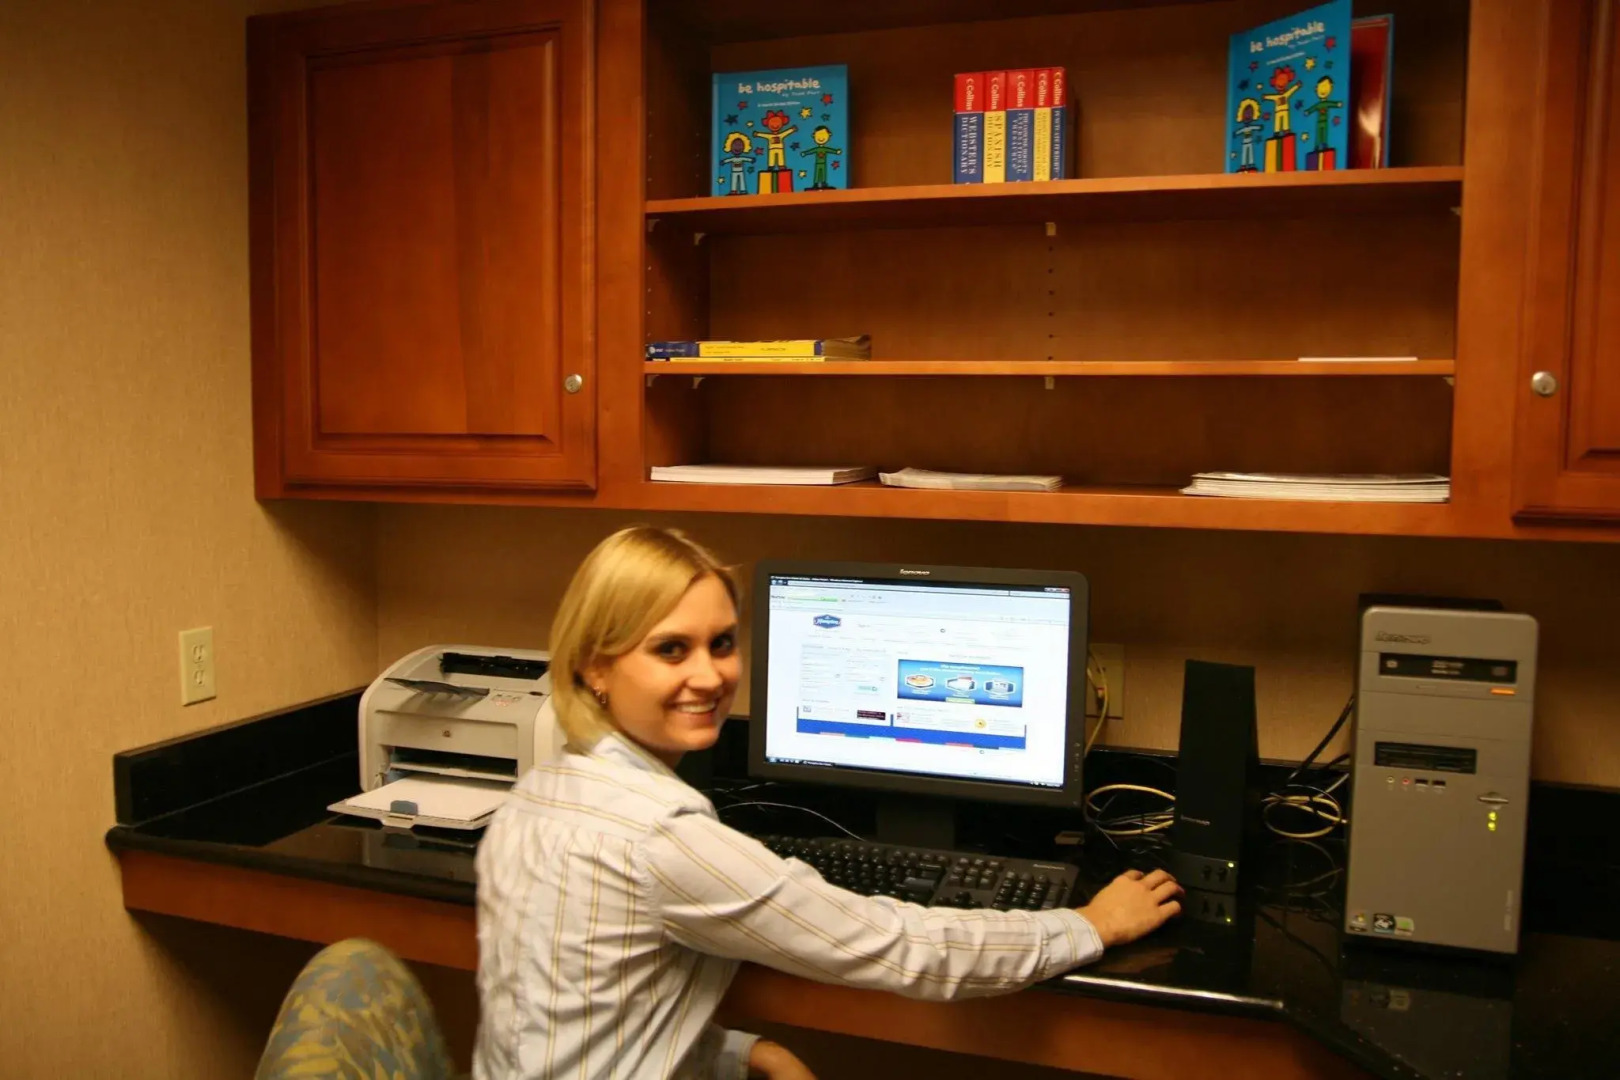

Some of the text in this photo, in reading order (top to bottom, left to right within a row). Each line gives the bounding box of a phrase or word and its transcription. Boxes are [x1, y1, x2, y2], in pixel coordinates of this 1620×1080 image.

[1250, 41, 1264, 53] be
[1266, 22, 1325, 47] hospitable
[738, 79, 820, 94] be hospitable
[966, 85, 975, 110] Collins
[991, 84, 999, 110] Collins
[1017, 81, 1026, 107] Collins
[1038, 79, 1047, 106] Collins
[1053, 78, 1062, 105] Collins
[968, 116, 978, 174] WEBSTER'S
[986, 116, 994, 168] DICTIONARY
[994, 115, 1002, 168] SPANISH
